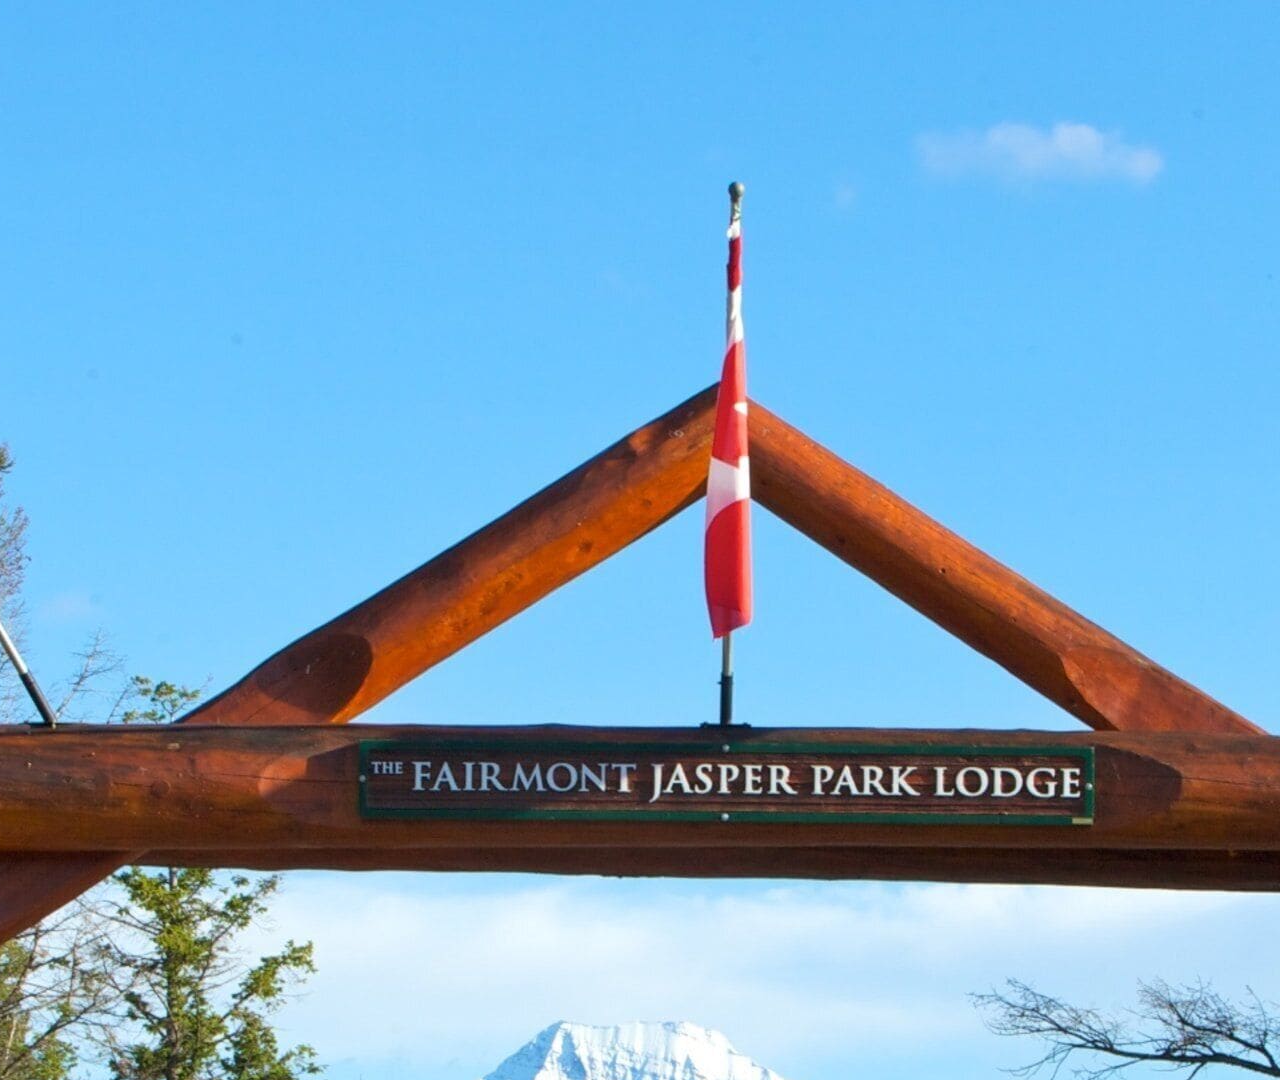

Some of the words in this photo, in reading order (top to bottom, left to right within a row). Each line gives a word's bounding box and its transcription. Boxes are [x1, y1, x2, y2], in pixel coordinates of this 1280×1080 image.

[371, 761, 403, 775] THE
[412, 761, 637, 793] FAIRMONT
[648, 763, 798, 803] JASPER
[810, 764, 920, 797] PARK
[933, 767, 1082, 799] LODGE
